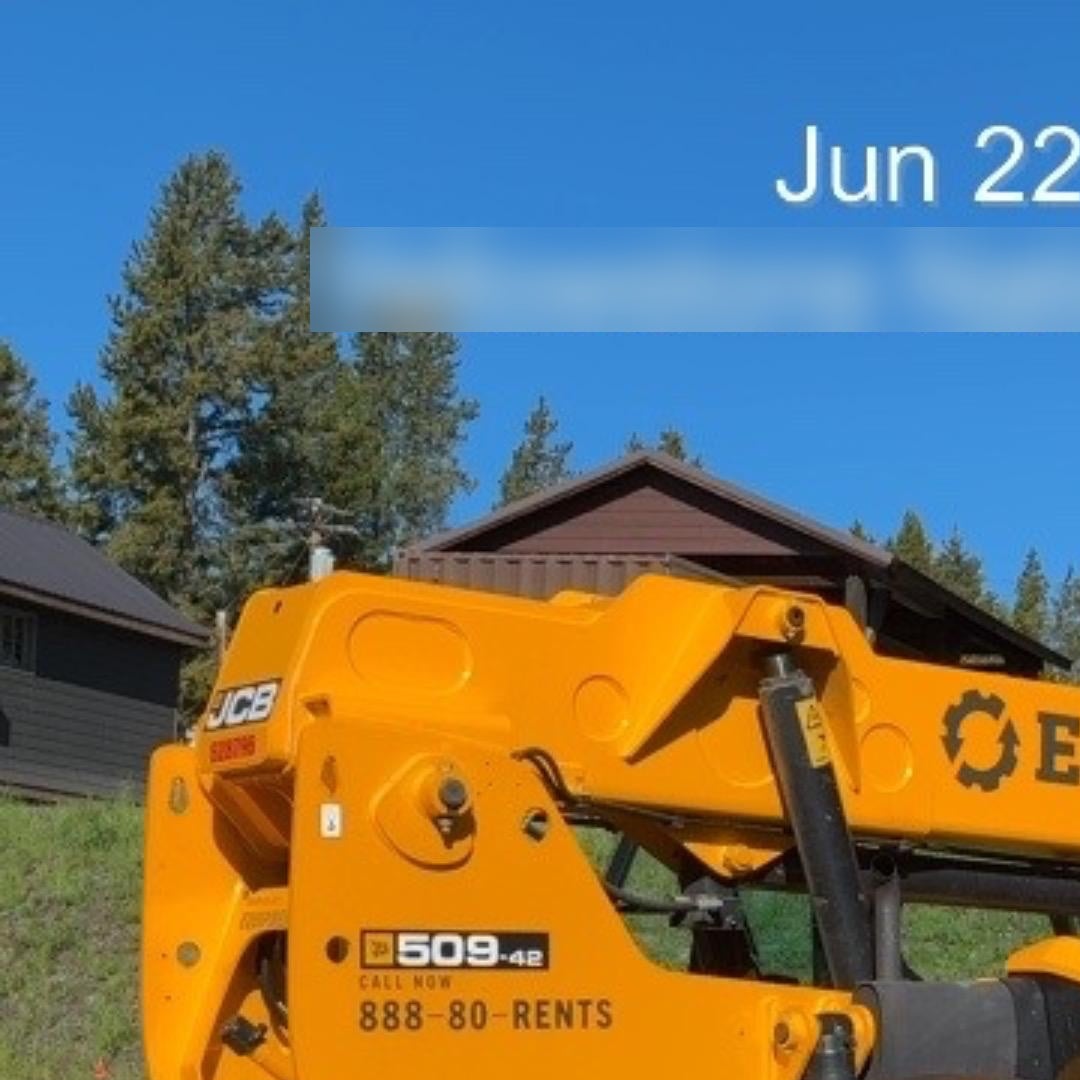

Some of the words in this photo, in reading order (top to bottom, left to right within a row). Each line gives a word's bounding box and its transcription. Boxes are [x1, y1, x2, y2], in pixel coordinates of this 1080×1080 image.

[206, 683, 278, 728] JCB
[359, 975, 404, 991] CALL
[413, 975, 454, 990] NOW
[359, 1000, 614, 1031] 888-80-RENTS
